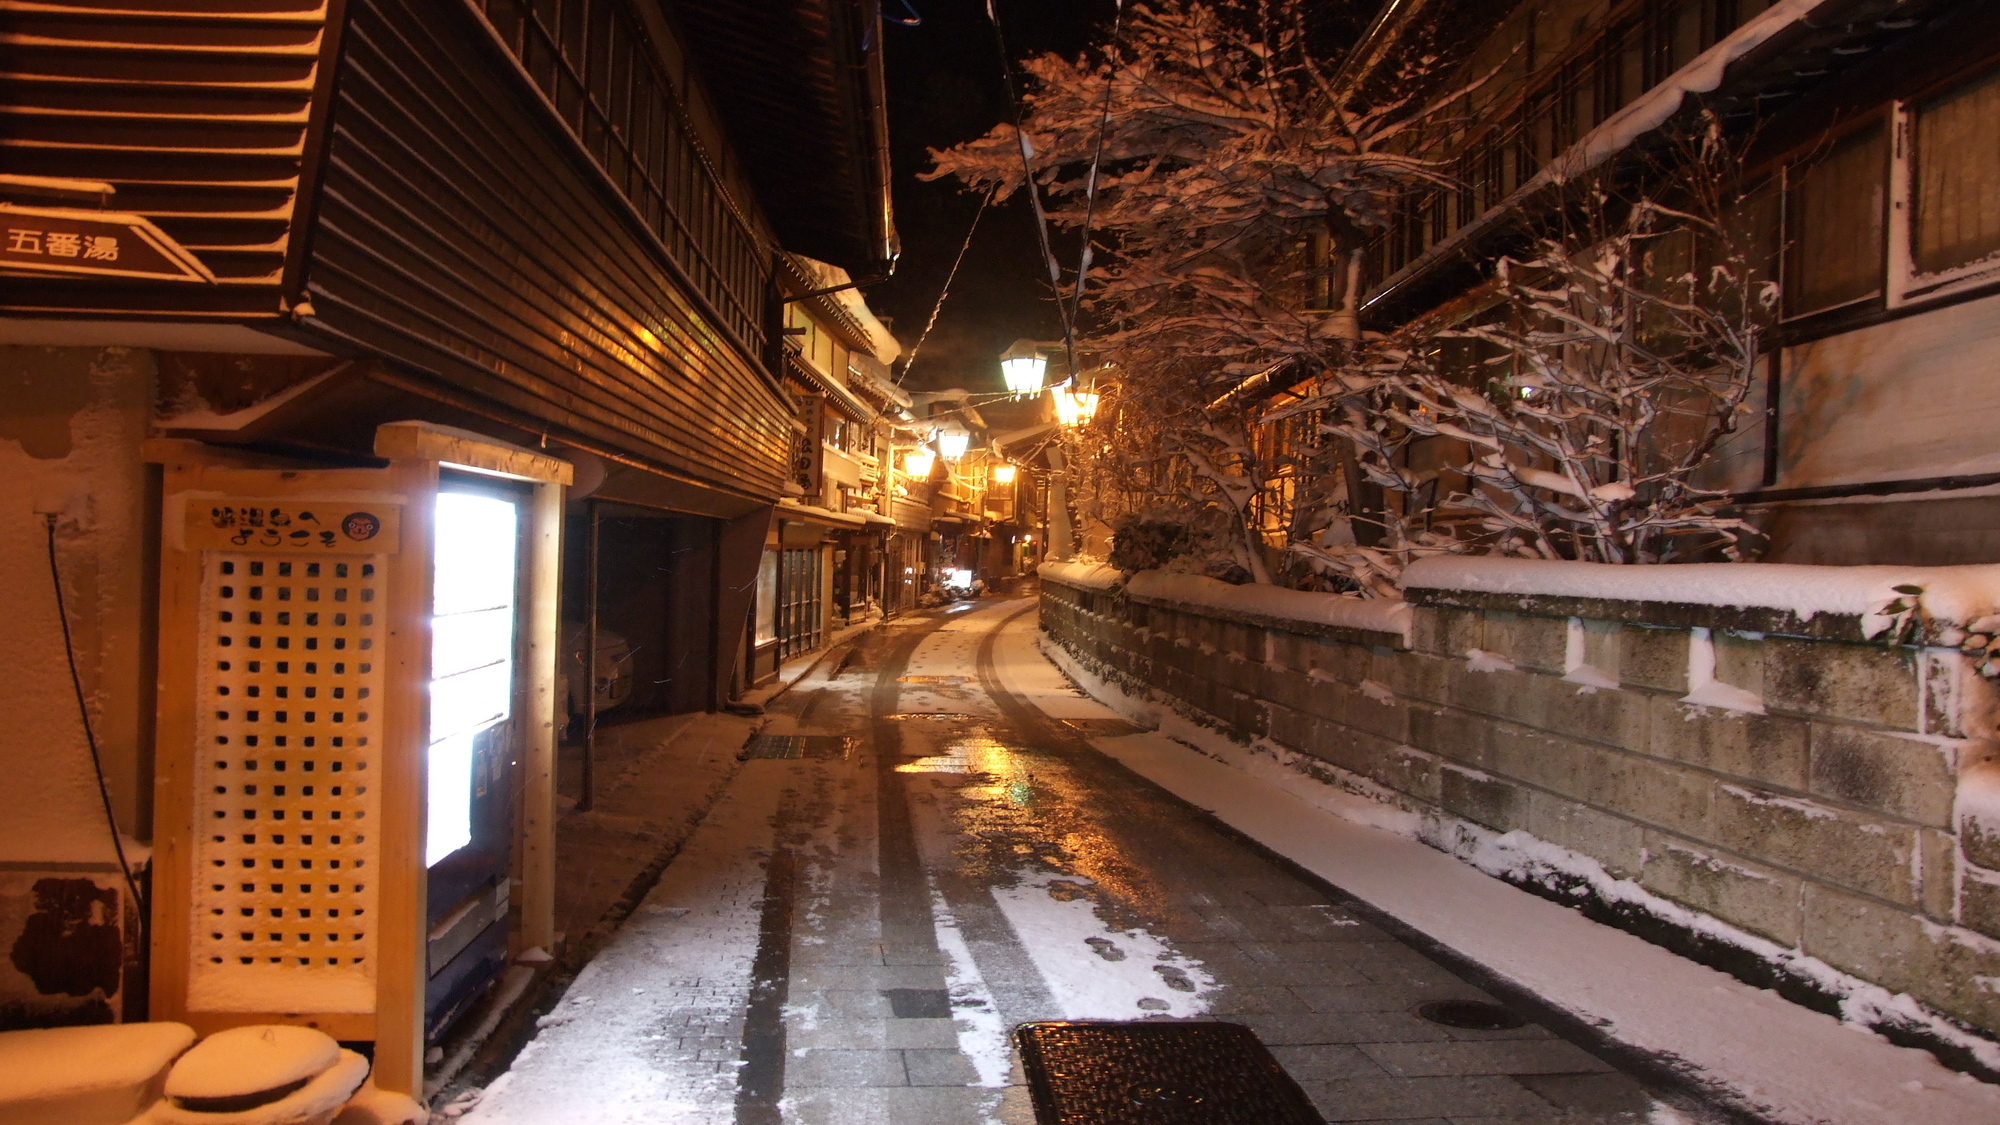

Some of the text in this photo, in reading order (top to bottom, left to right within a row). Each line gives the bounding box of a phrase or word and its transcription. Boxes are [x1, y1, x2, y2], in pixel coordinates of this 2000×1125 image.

[6, 228, 119, 261] 五番湯
[231, 528, 337, 548] ようこそ
